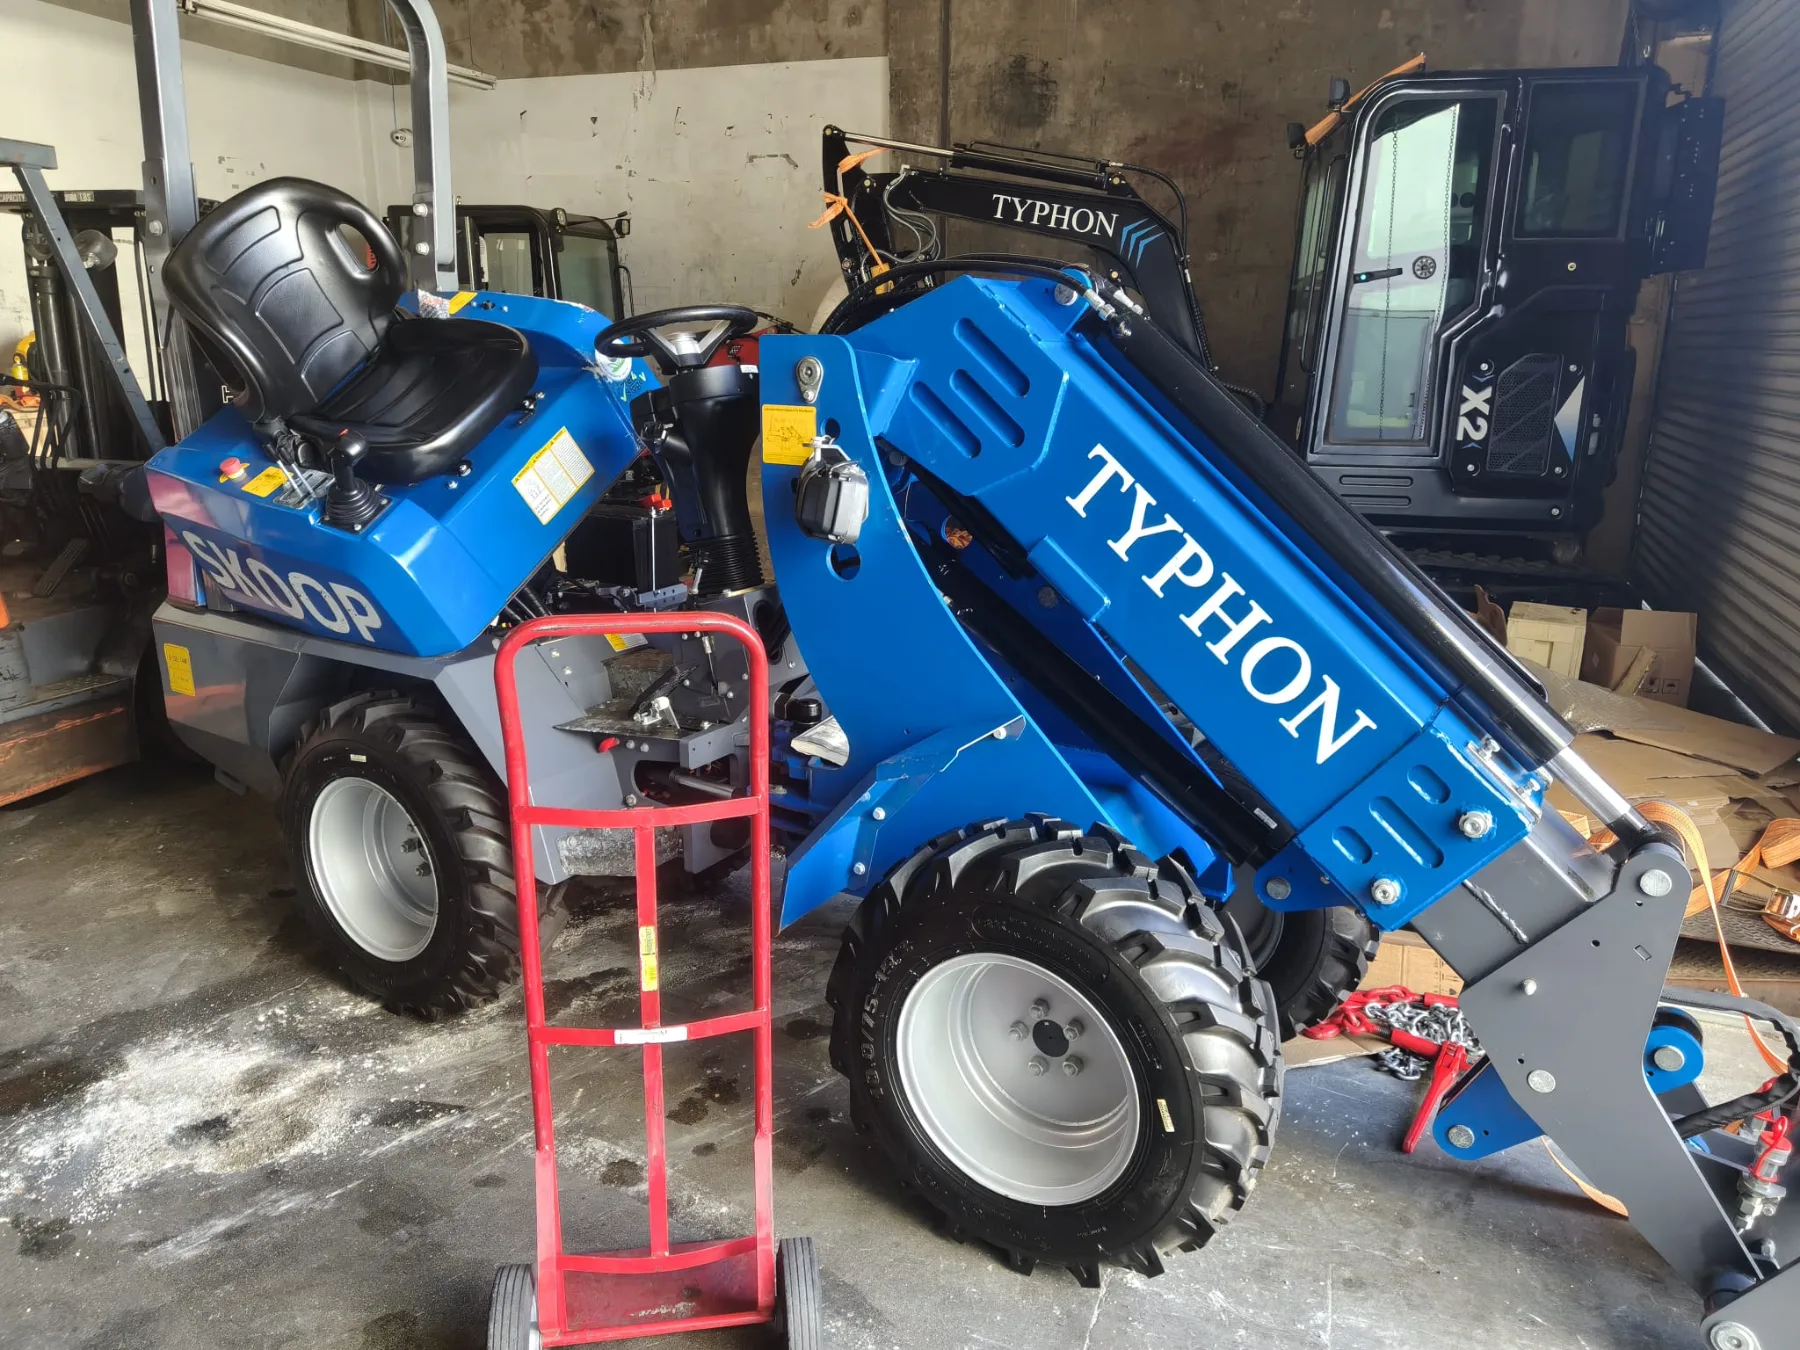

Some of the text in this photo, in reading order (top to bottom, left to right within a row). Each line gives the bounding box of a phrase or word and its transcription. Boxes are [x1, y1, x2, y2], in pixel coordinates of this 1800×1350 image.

[992, 194, 1119, 238] TYPHON
[1456, 384, 1492, 441] X2
[182, 530, 382, 643] SKOOP
[1065, 443, 1377, 765] TYPHON
